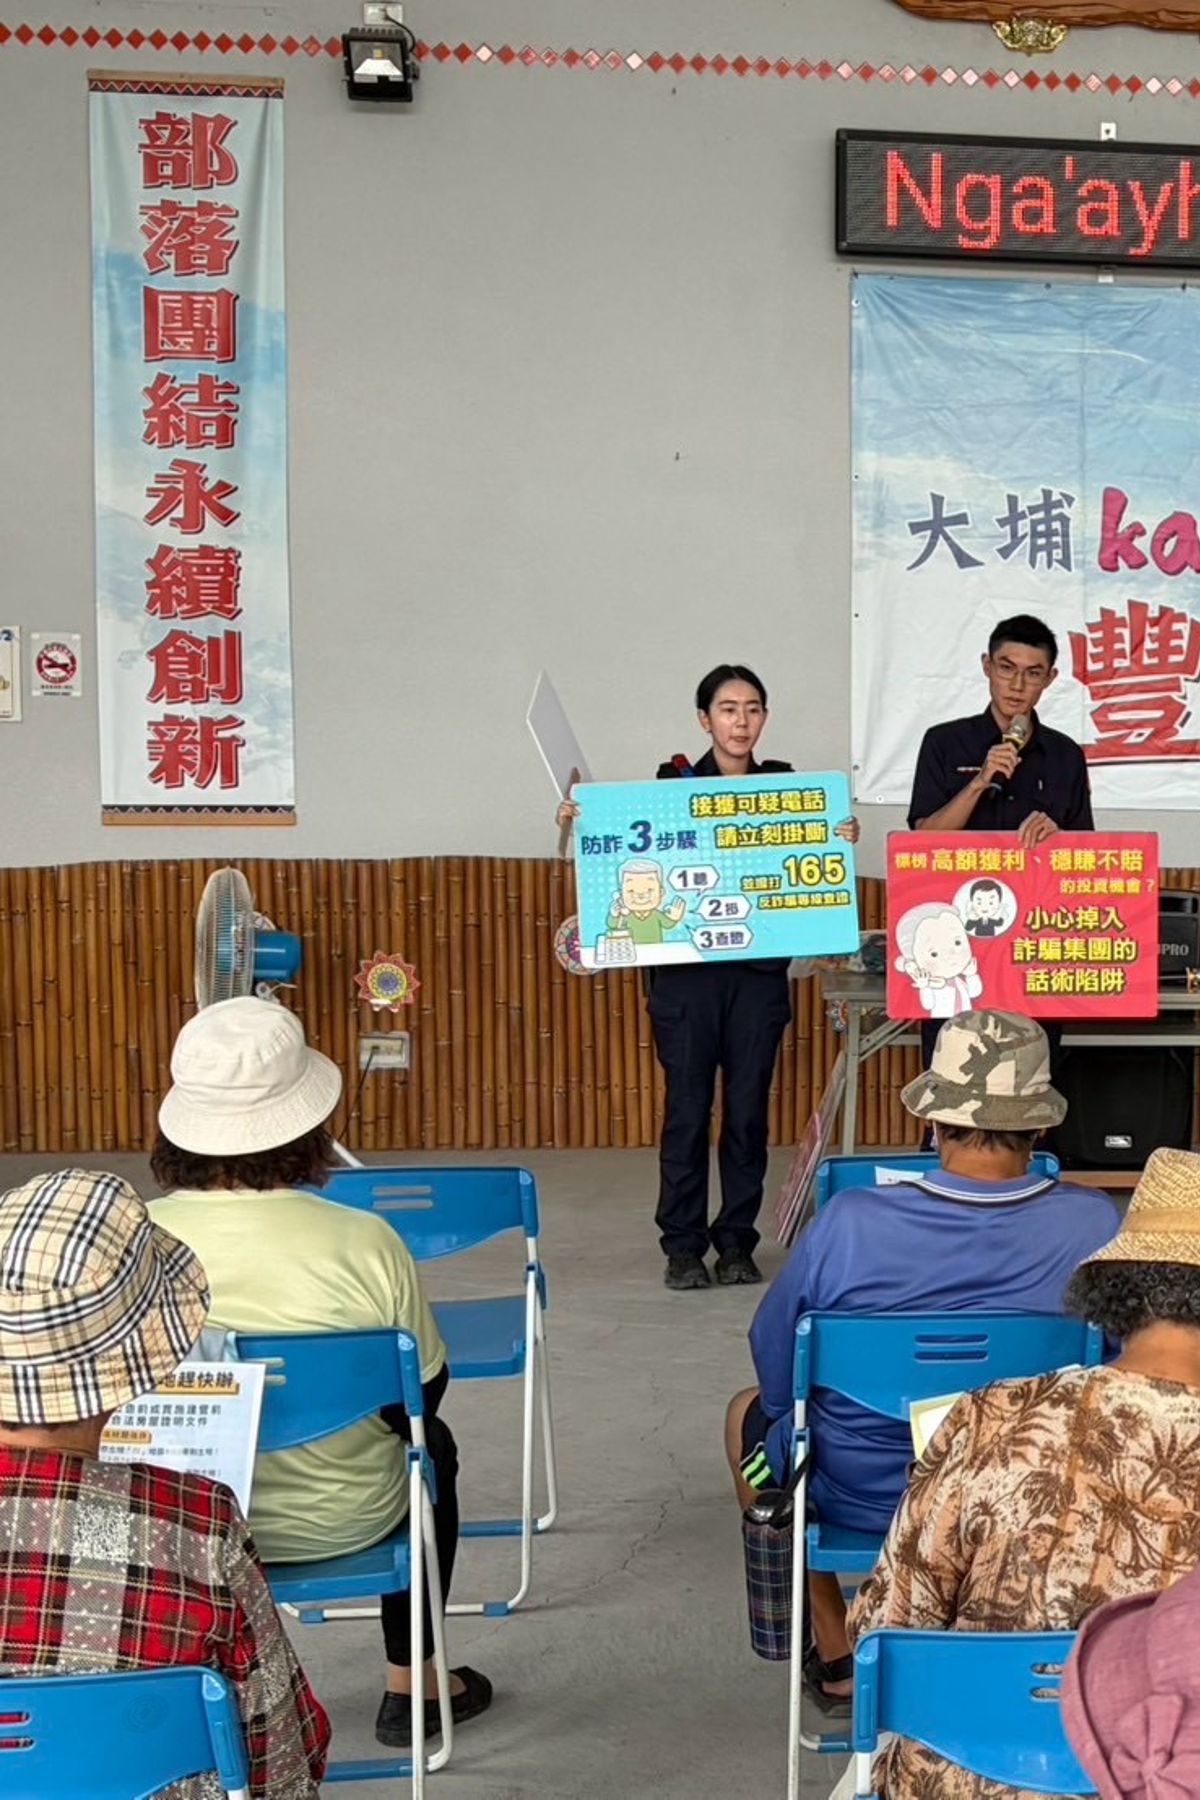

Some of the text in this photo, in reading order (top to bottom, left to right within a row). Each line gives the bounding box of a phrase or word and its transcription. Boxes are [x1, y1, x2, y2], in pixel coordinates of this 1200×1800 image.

[138, 111, 244, 790] 部落團結永續創新
[907, 488, 1075, 574] 大埔
[690, 788, 826, 818] 接獲可疑電話
[714, 819, 828, 849] 請立刻掛斷
[1025, 905, 1126, 931] 小心掉入
[1011, 936, 1138, 963] 詐騙集團的
[1023, 967, 1127, 994] 話術陷阱
